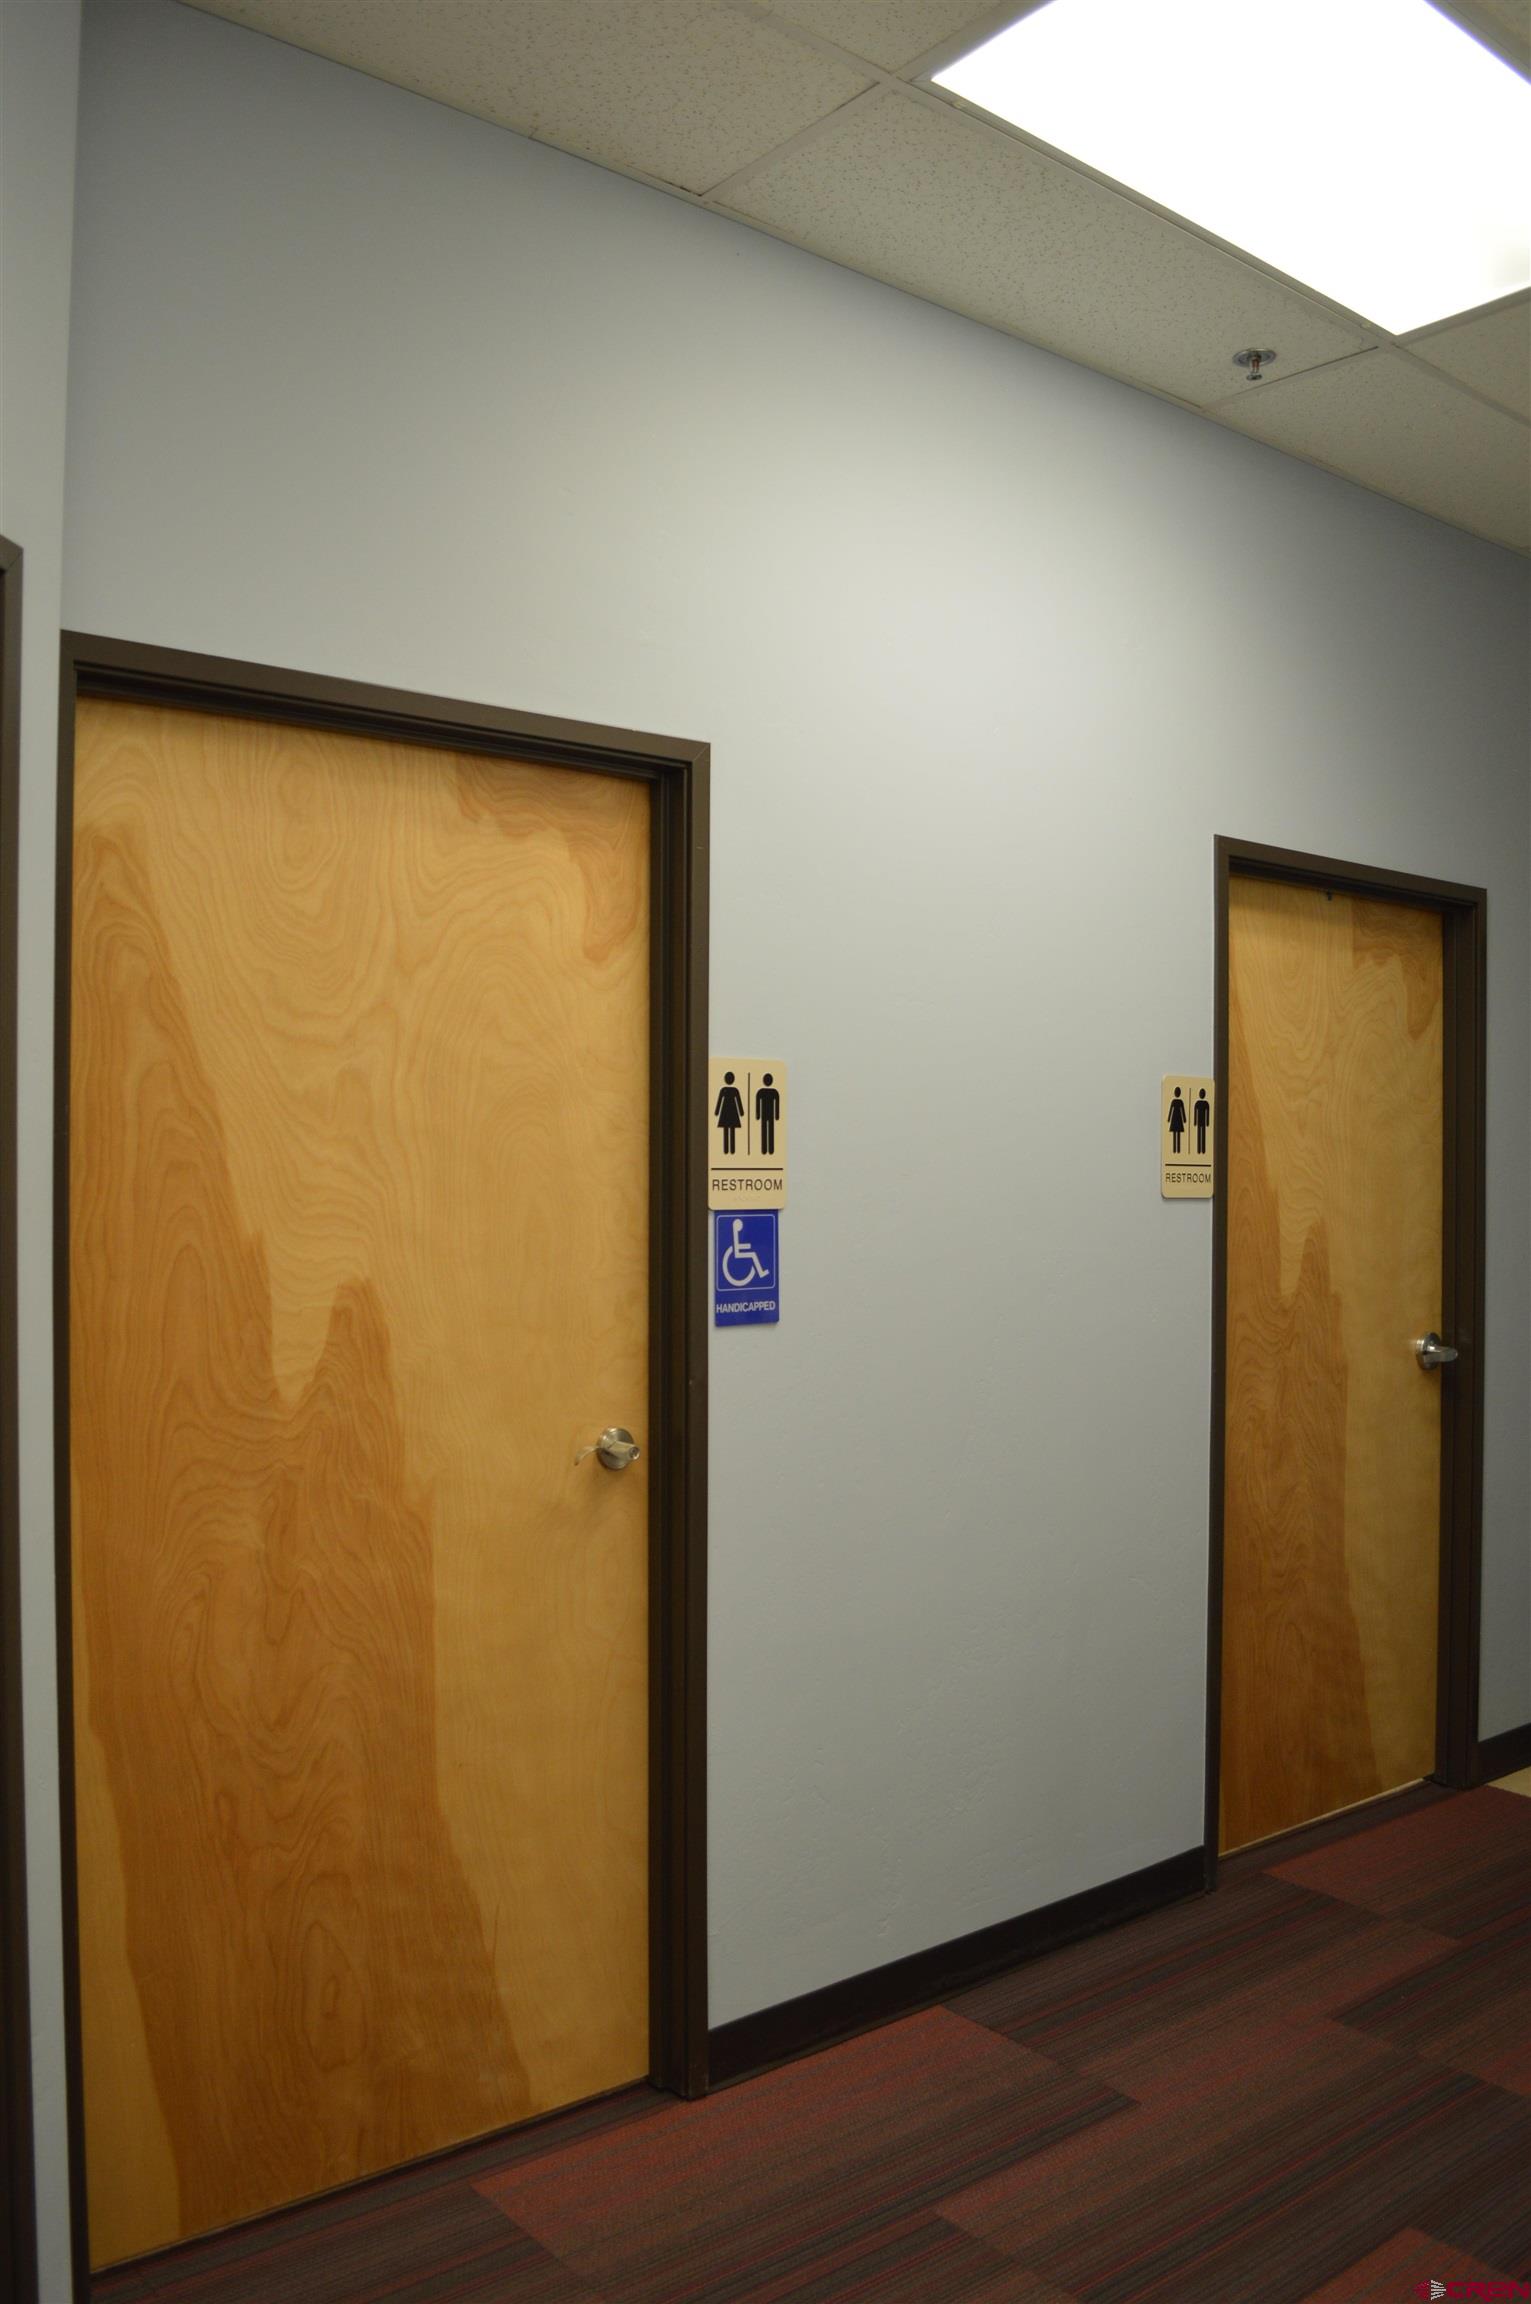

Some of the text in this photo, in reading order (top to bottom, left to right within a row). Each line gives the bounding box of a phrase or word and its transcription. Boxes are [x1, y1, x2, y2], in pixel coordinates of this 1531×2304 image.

[1165, 1173, 1211, 1183] RESTROOM
[712, 1179, 783, 1191] RESTROOM
[716, 1301, 775, 1313] HANDICAPPED
